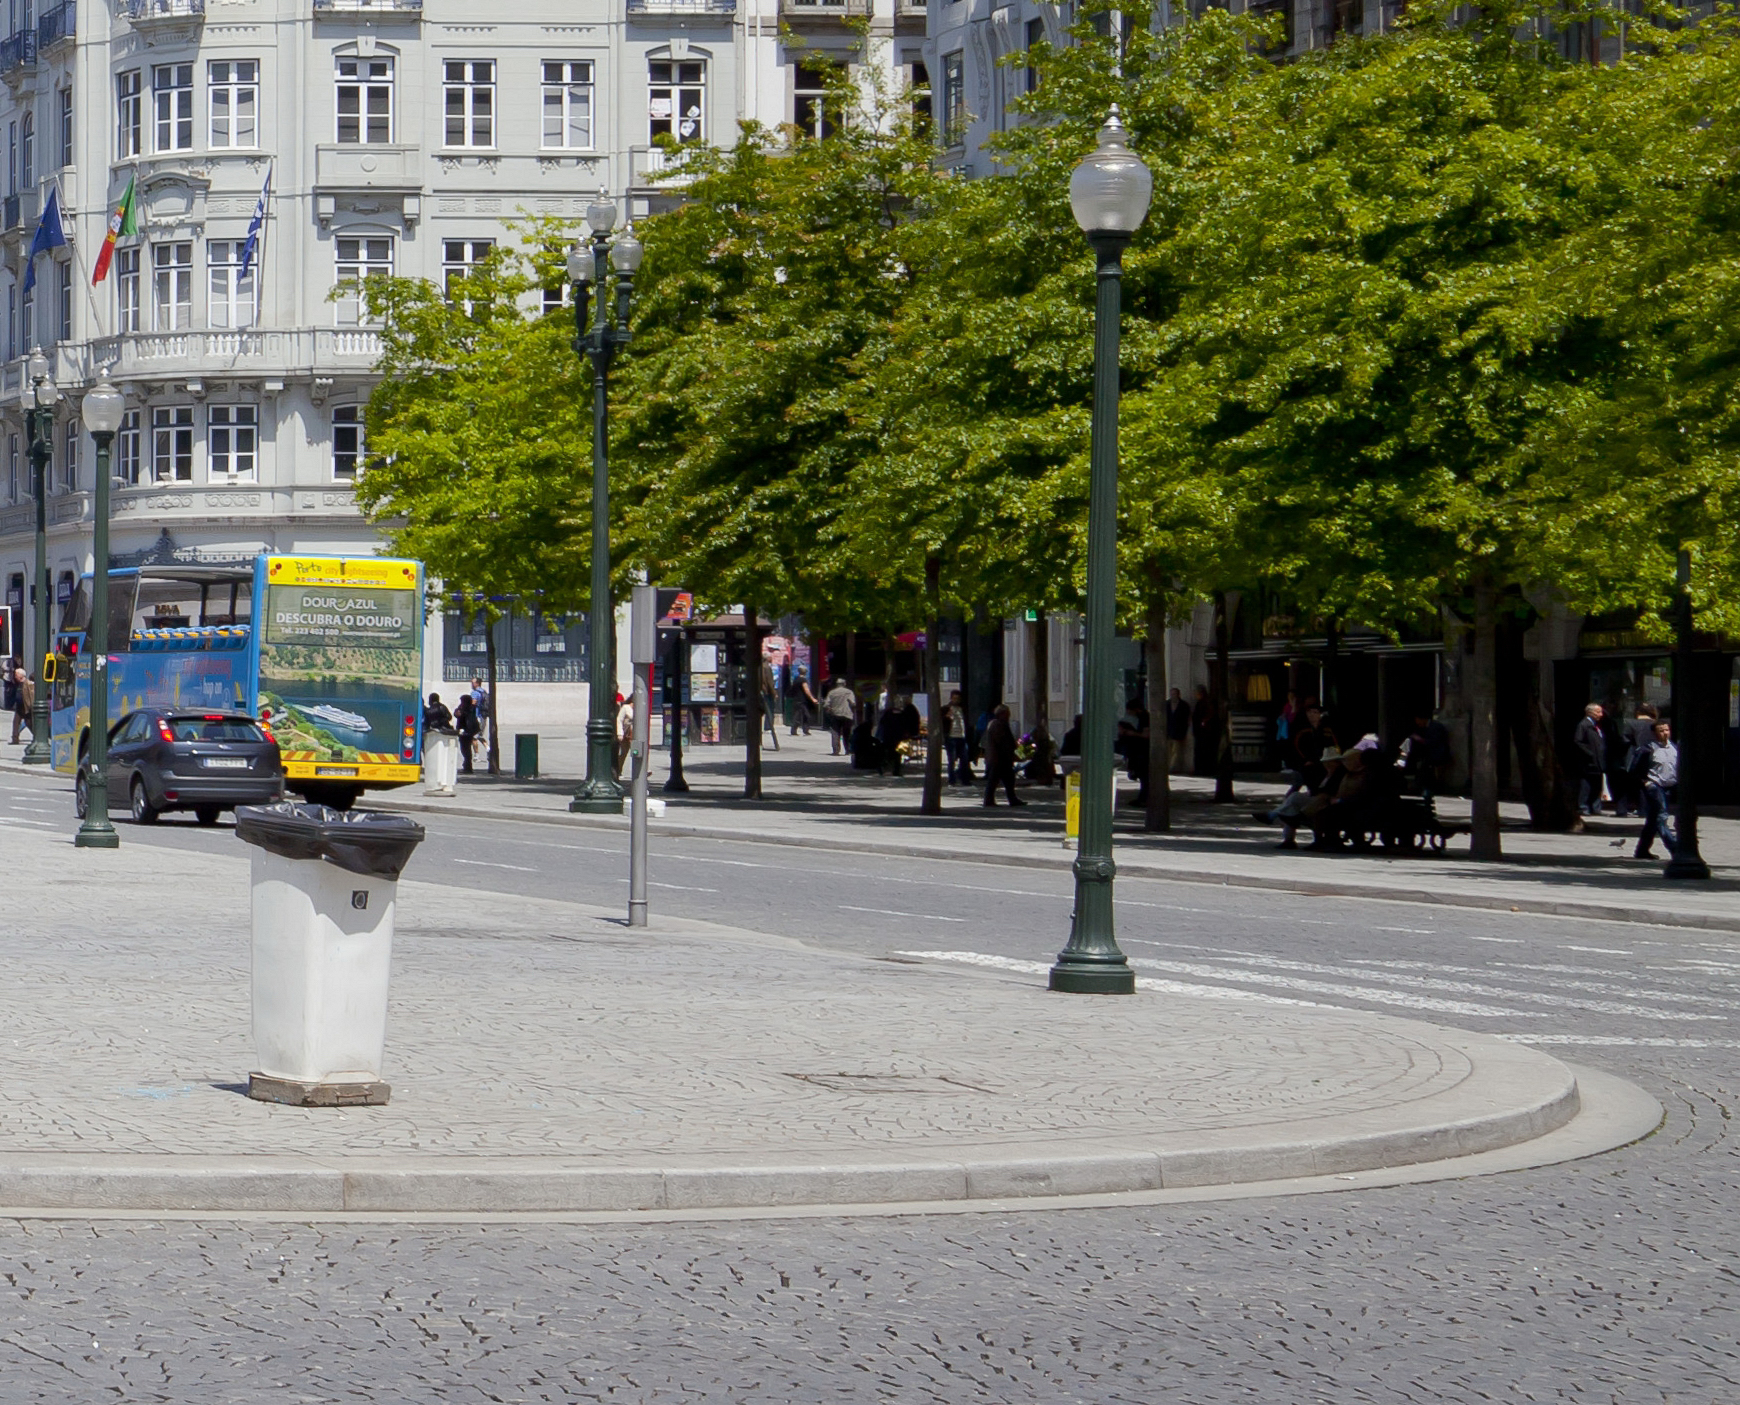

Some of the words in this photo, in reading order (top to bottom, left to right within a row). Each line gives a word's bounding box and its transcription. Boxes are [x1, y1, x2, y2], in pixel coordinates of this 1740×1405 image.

[294, 561, 322, 574] Porto
[276, 612, 341, 625] DESCUBRA
[344, 615, 354, 626] O
[356, 616, 402, 628] DOURO
